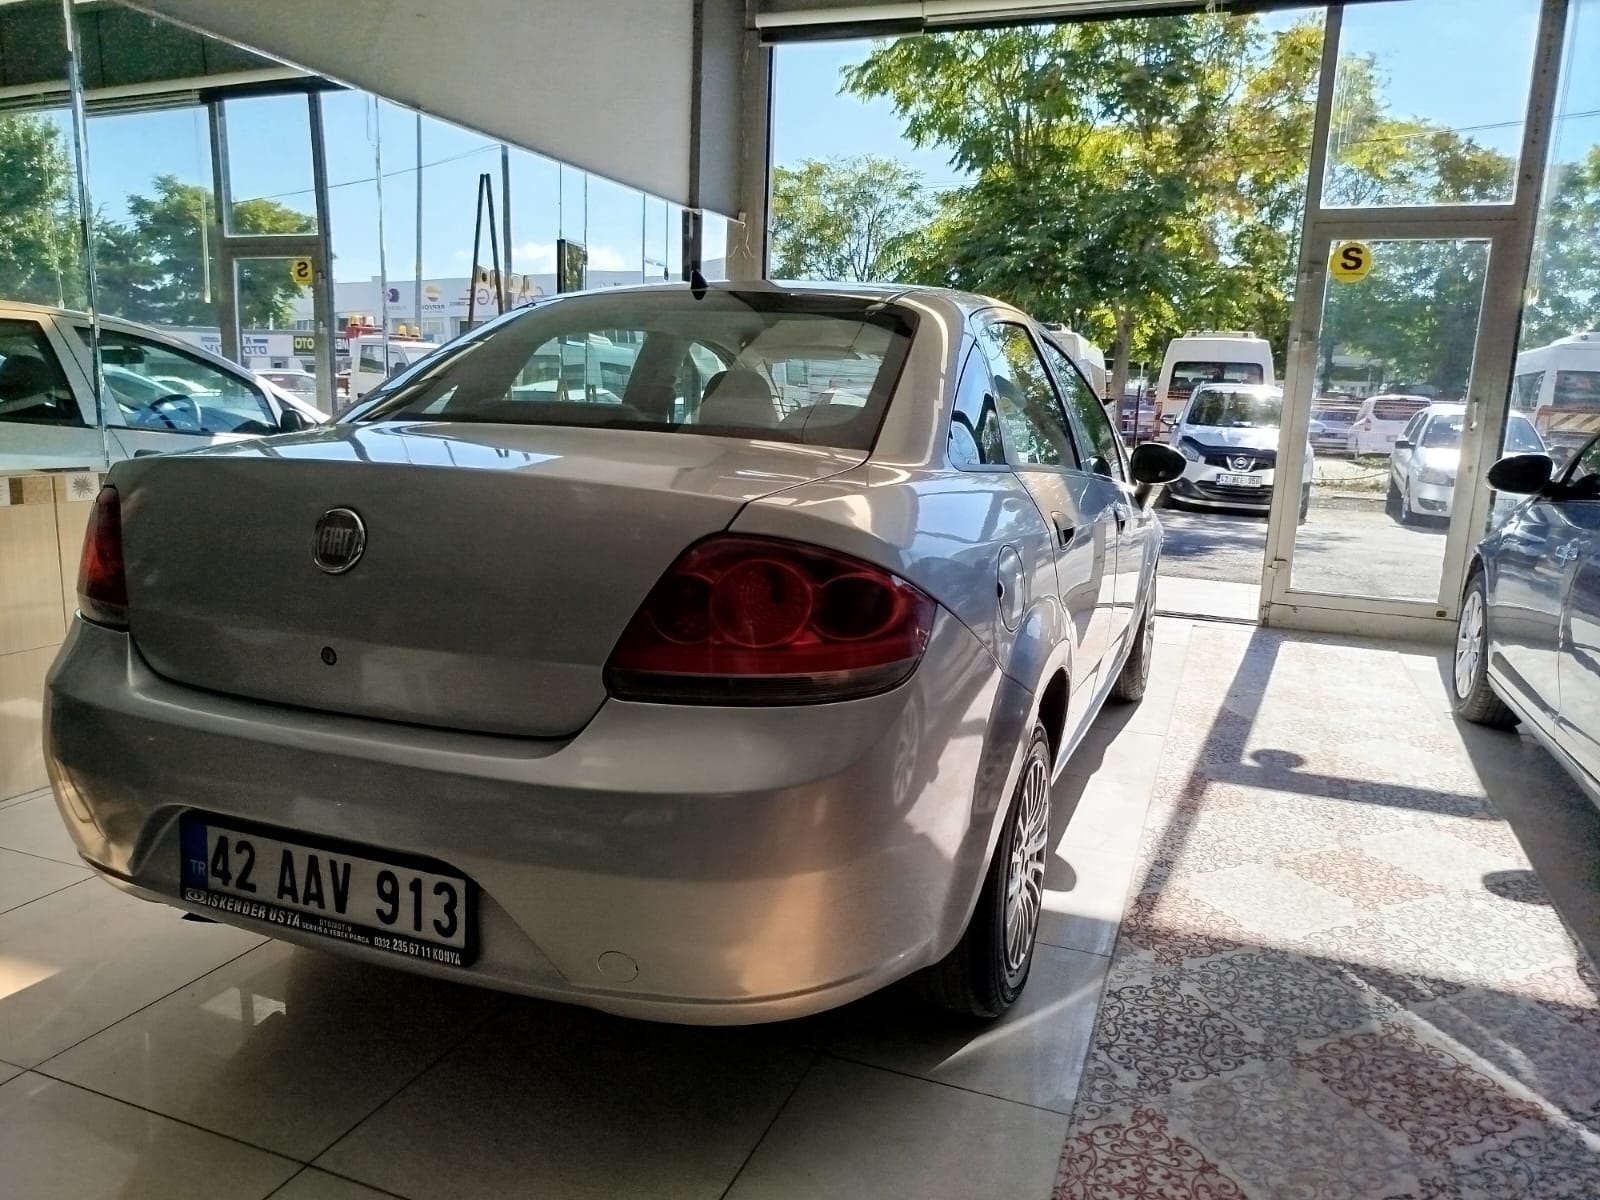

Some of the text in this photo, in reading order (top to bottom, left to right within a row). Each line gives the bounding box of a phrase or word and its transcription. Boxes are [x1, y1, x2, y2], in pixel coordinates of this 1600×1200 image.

[1340, 246, 1363, 270] S
[320, 526, 353, 556] FIAT
[190, 858, 207, 876] TR
[210, 835, 458, 939] 42 AAV 913
[269, 907, 301, 928] USTA
[432, 947, 462, 966] KONYA
